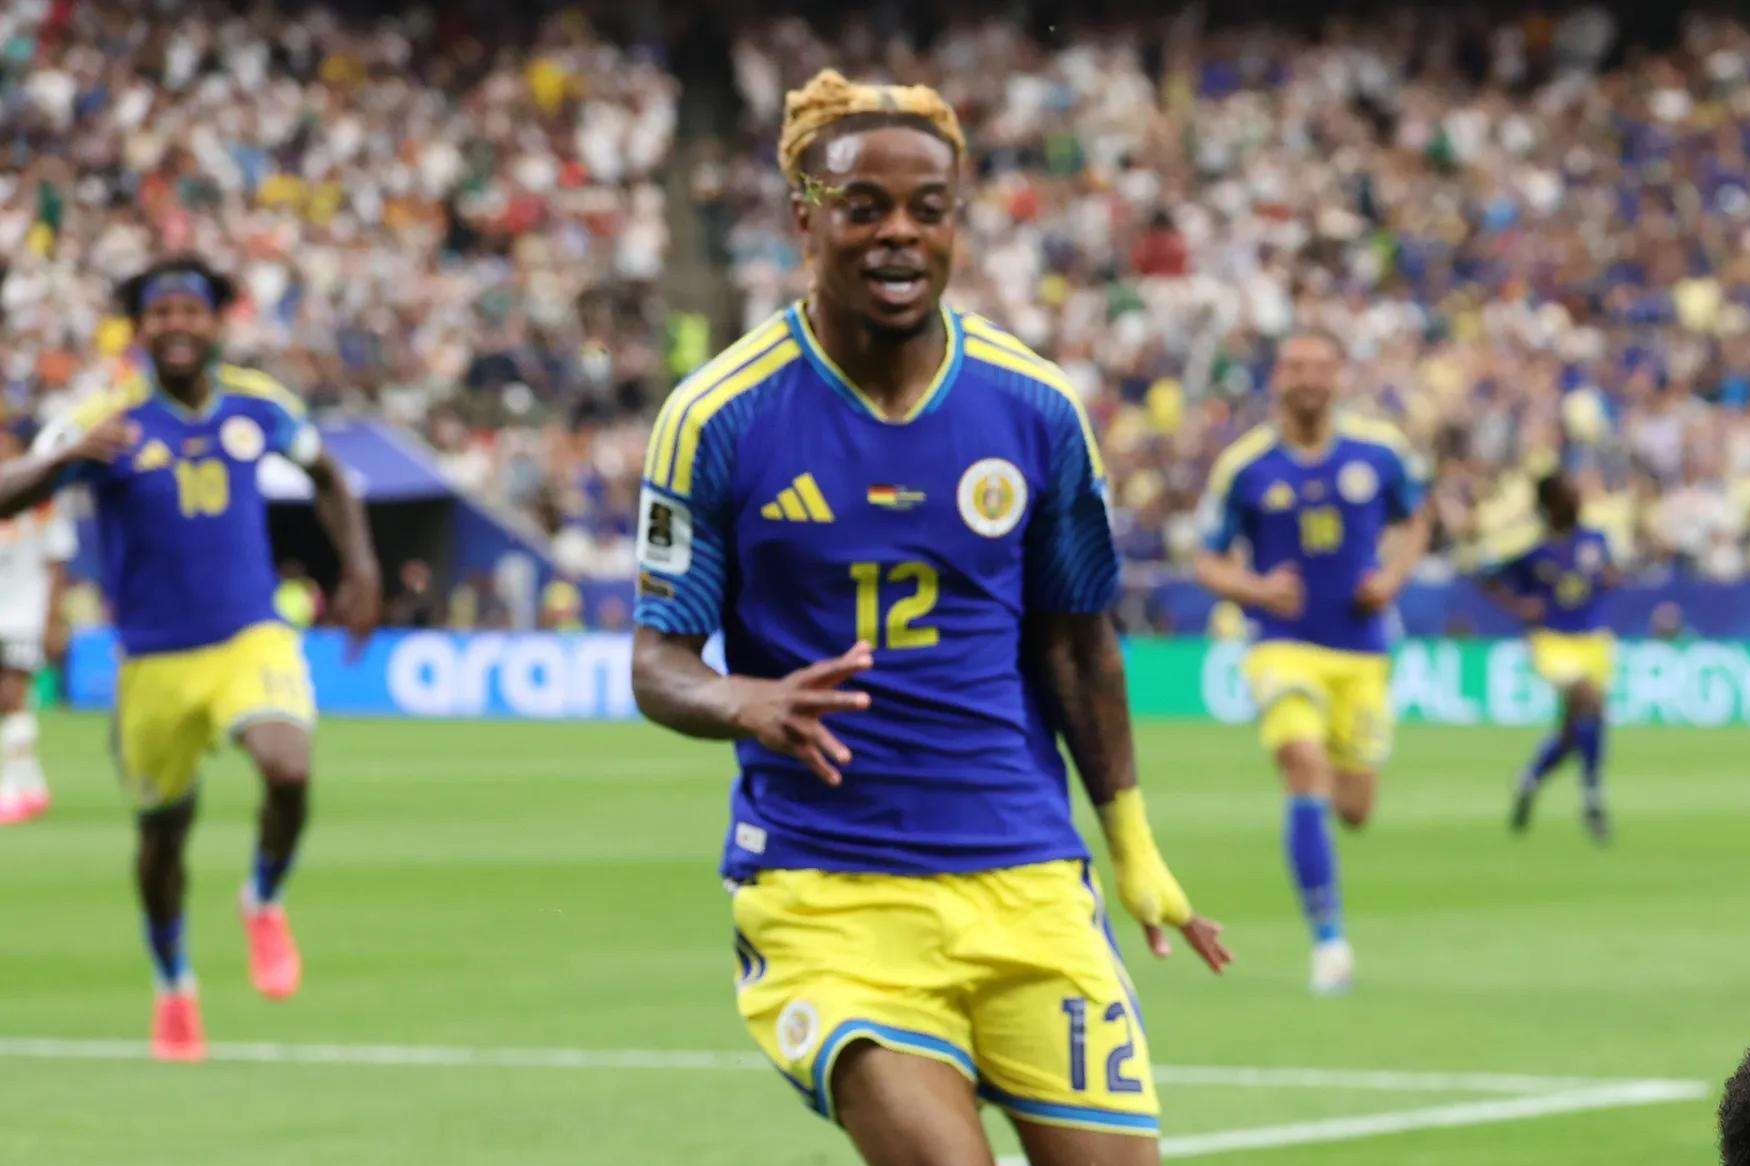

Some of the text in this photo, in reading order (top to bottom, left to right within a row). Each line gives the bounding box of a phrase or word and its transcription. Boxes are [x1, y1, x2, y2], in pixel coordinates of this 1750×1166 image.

[849, 562, 940, 650] 12
[387, 632, 728, 717] aram
[1062, 996, 1143, 1093] 12
